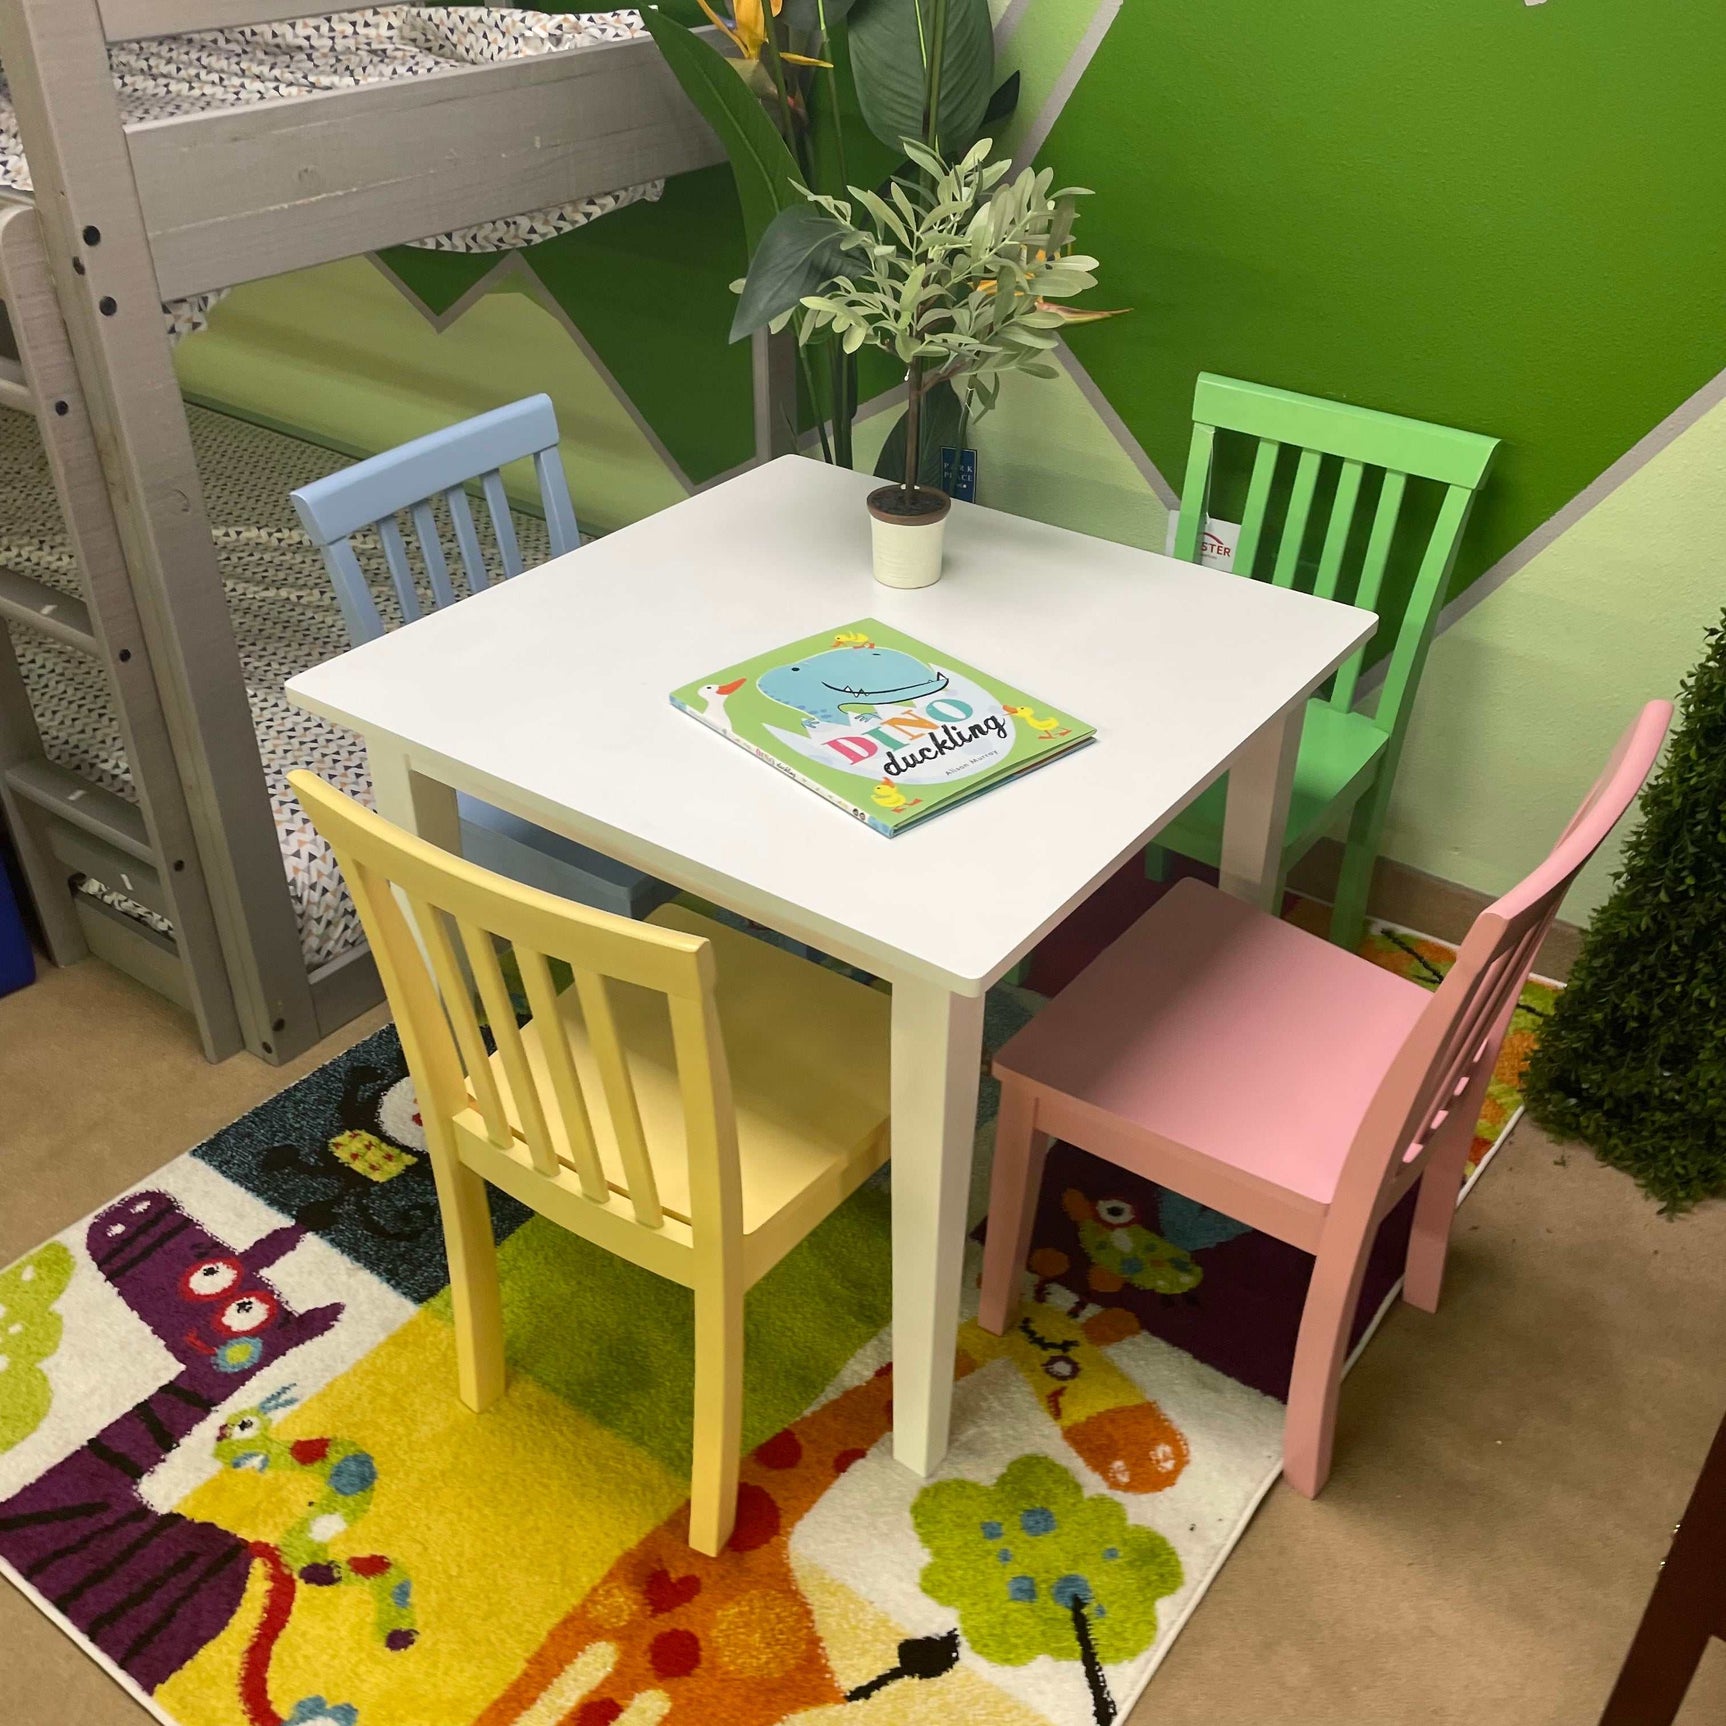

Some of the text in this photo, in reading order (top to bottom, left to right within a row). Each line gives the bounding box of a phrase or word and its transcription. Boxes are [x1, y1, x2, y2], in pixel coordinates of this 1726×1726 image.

[943, 462, 973, 473] PRK
[943, 471, 973, 482] PLCE
[821, 698, 973, 765] DINO
[883, 715, 1007, 776] duckling
[945, 763, 969, 776] Alison
